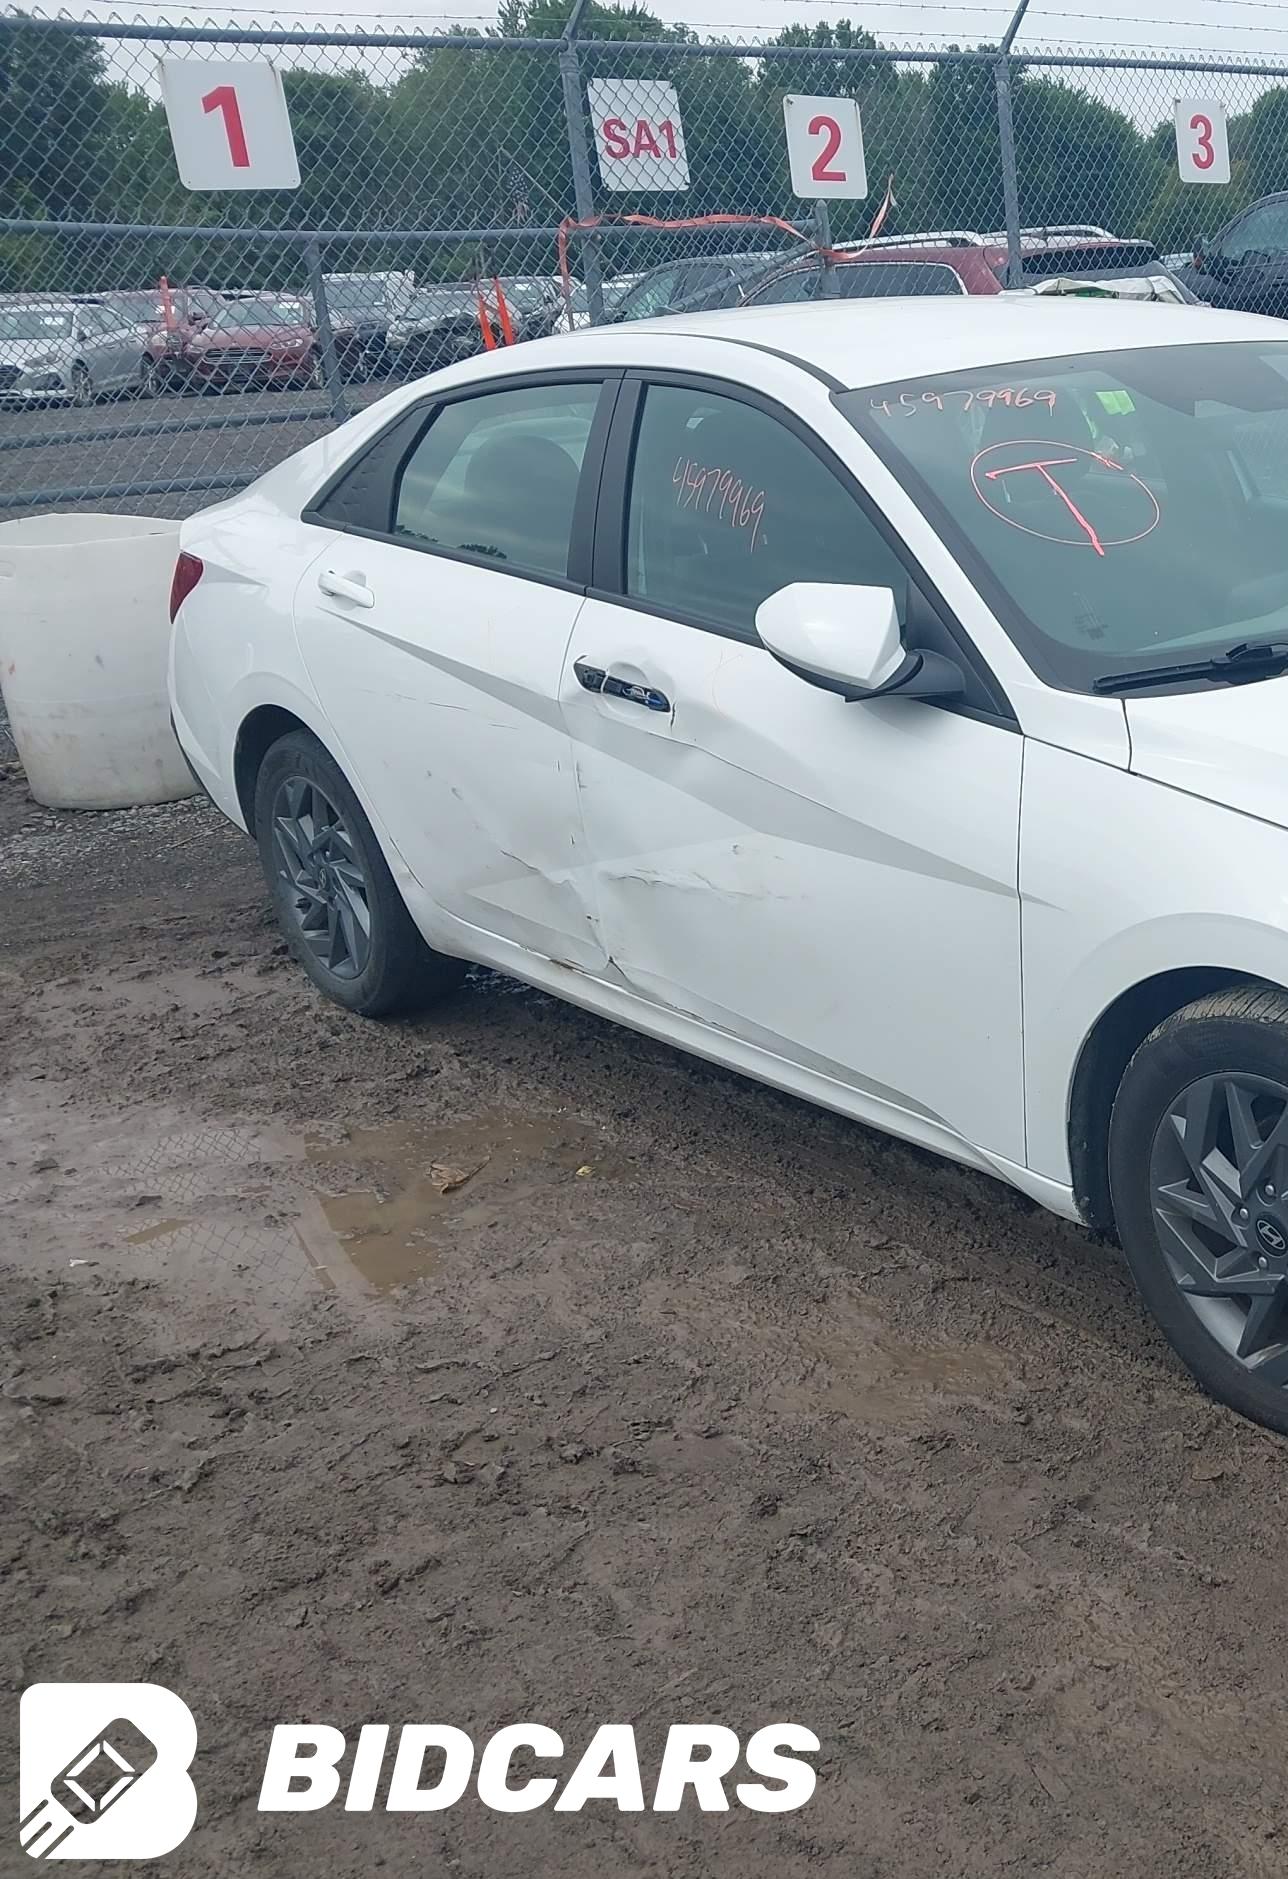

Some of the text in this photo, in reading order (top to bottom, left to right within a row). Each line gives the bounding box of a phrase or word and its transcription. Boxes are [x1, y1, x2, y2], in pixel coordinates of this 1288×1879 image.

[202, 86, 250, 167] 1
[602, 118, 677, 159] SA1
[808, 115, 847, 181] 2
[1190, 113, 1215, 170] 3
[870, 387, 1056, 417] 45979969
[672, 456, 765, 553] 45979969
[985, 458, 1105, 556] T
